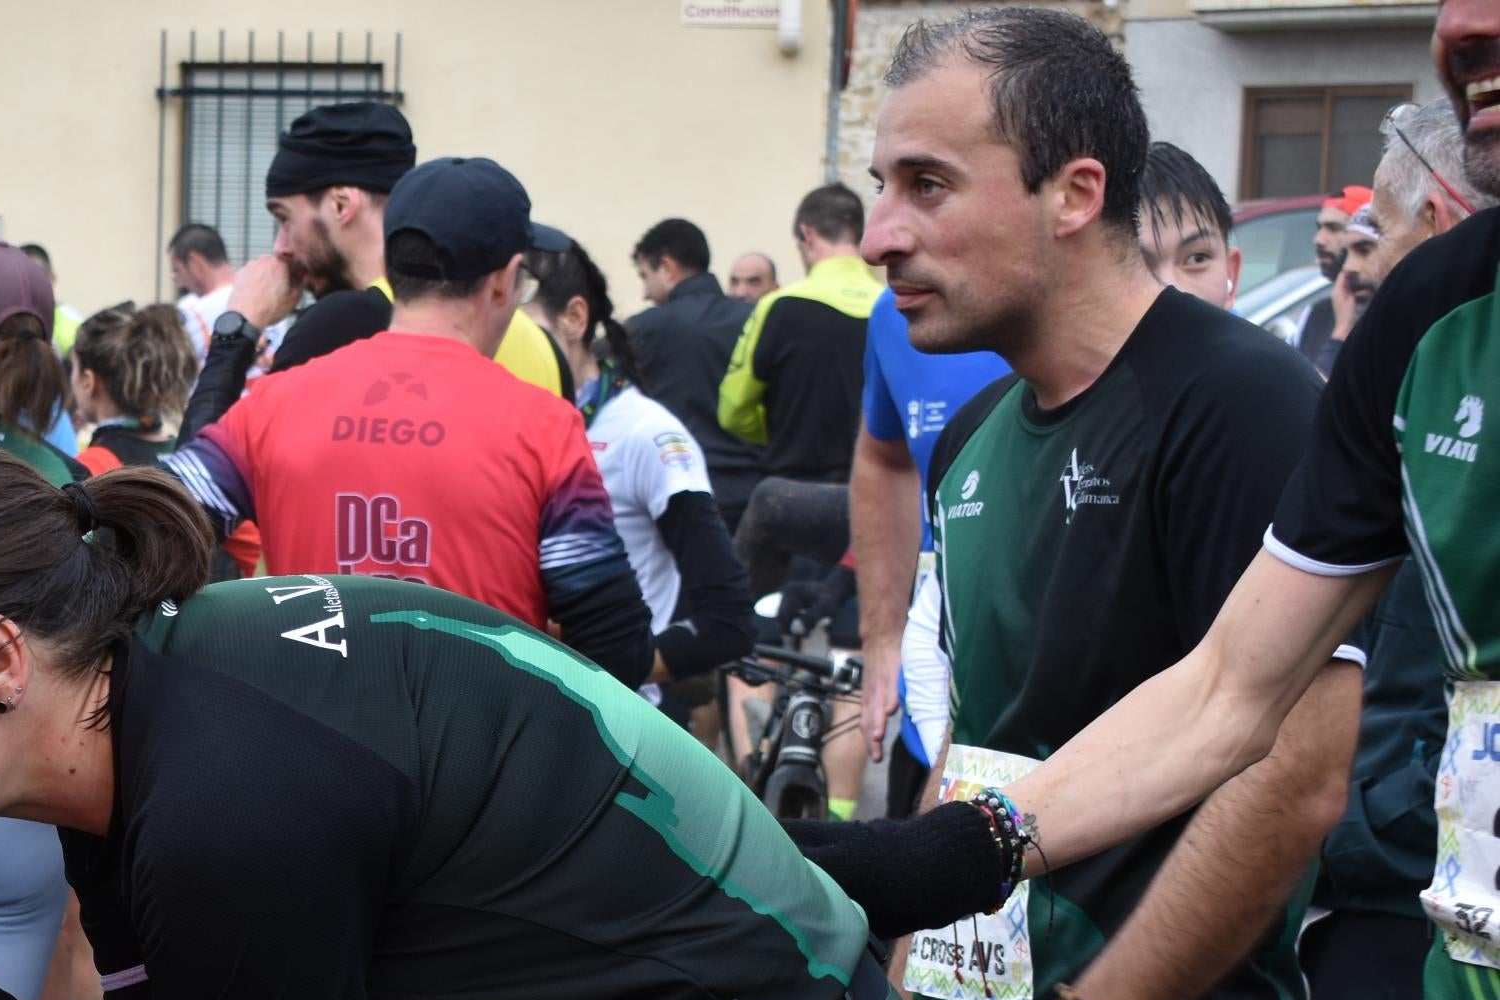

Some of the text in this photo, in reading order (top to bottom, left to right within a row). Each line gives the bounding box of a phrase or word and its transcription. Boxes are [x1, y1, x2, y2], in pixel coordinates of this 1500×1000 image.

[331, 415, 446, 447] DIEGO
[947, 501, 985, 520] VIATOR
[334, 492, 432, 567] DCa
[969, 938, 1006, 976] AVS
